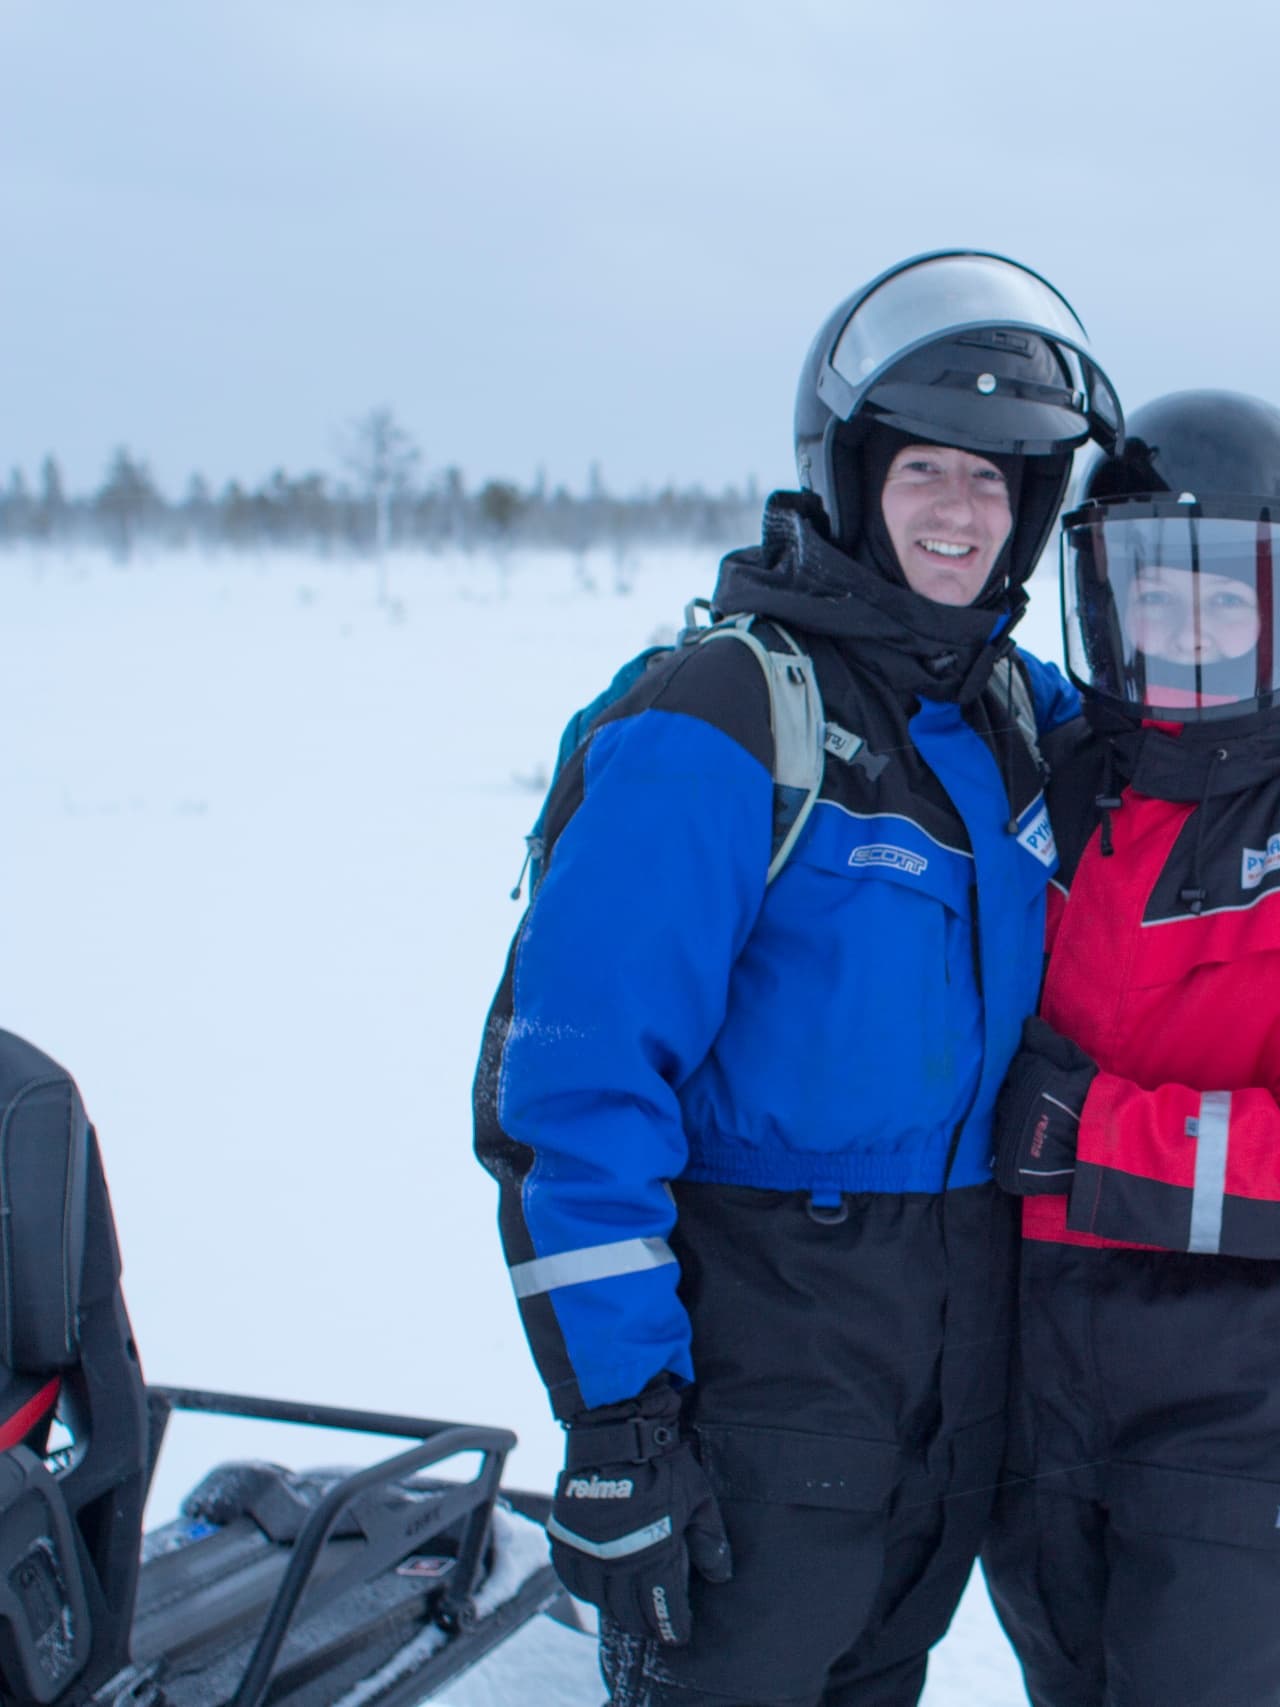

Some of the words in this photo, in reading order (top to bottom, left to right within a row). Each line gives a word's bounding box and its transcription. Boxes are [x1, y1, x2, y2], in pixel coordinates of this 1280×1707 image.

[1026, 818, 1052, 849] PYH
[850, 846, 927, 875] SCOTT
[565, 1475, 634, 1499] reima
